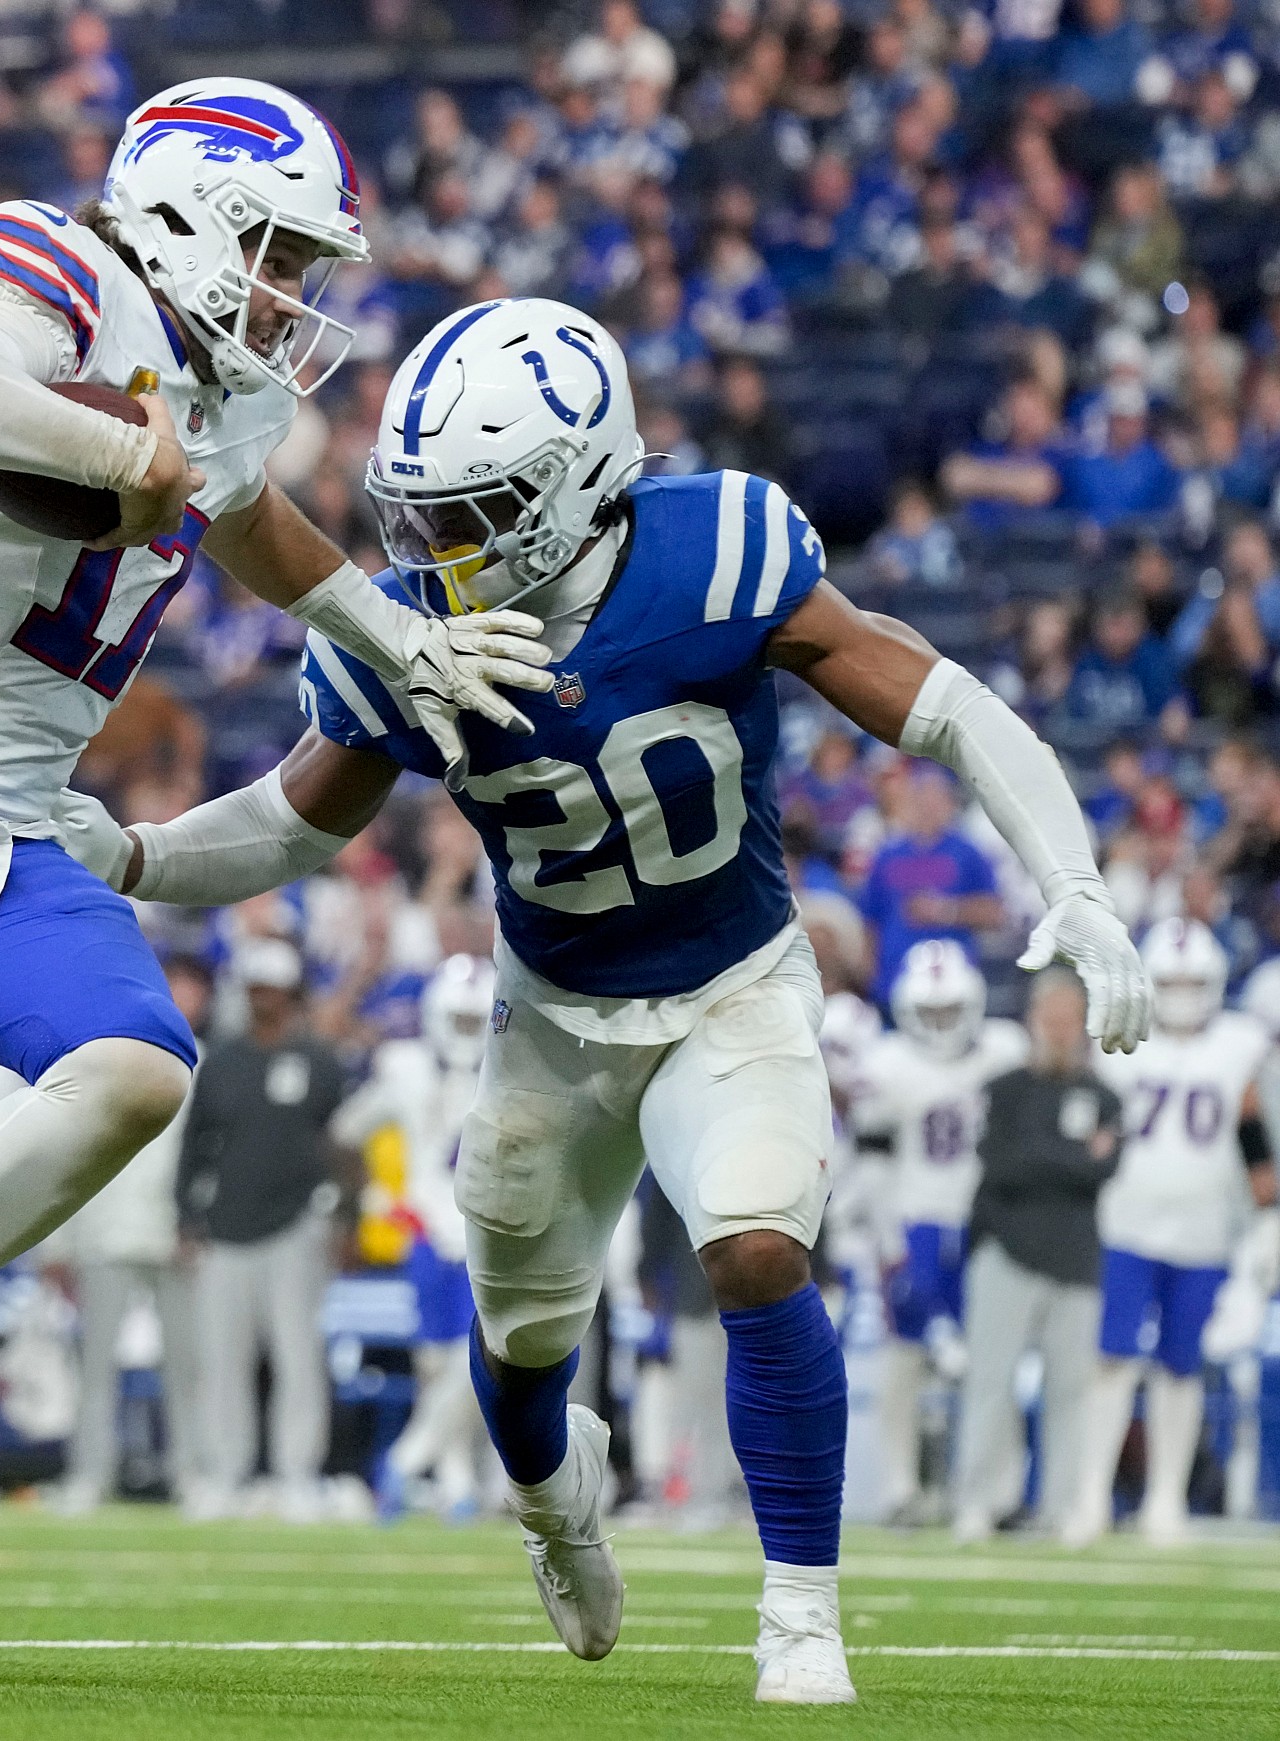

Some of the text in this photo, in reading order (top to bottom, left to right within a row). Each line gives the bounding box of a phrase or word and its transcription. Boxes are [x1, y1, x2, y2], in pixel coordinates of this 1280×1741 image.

[463, 469, 500, 481] OAKLEY
[10, 501, 212, 702] 17
[467, 701, 748, 915] 20
[1136, 1081, 1223, 1145] 70
